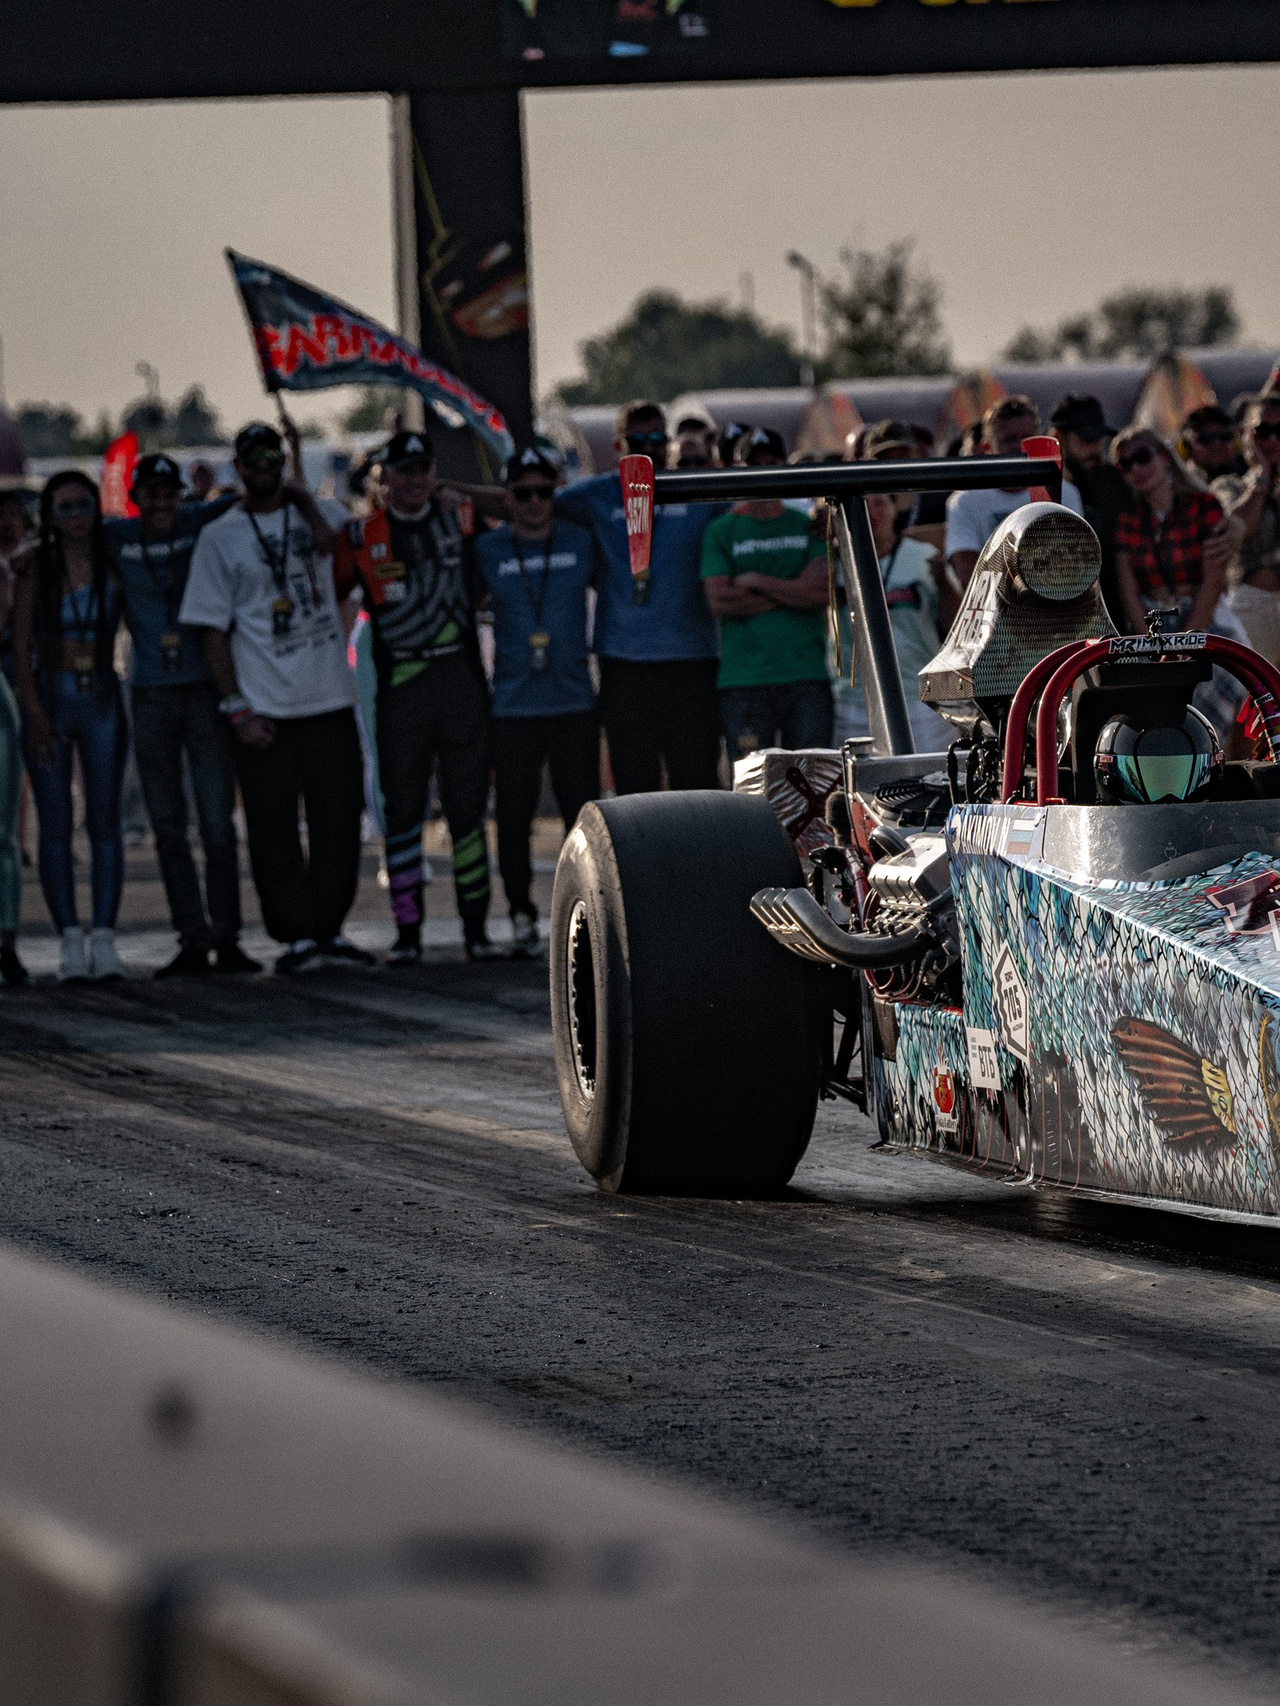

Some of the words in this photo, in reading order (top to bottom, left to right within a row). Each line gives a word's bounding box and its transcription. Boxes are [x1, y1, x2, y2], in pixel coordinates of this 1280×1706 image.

[961, 814, 1001, 856] AKIMOV
[1003, 984, 1022, 1023] 705
[978, 1045, 996, 1079] ВТБ
